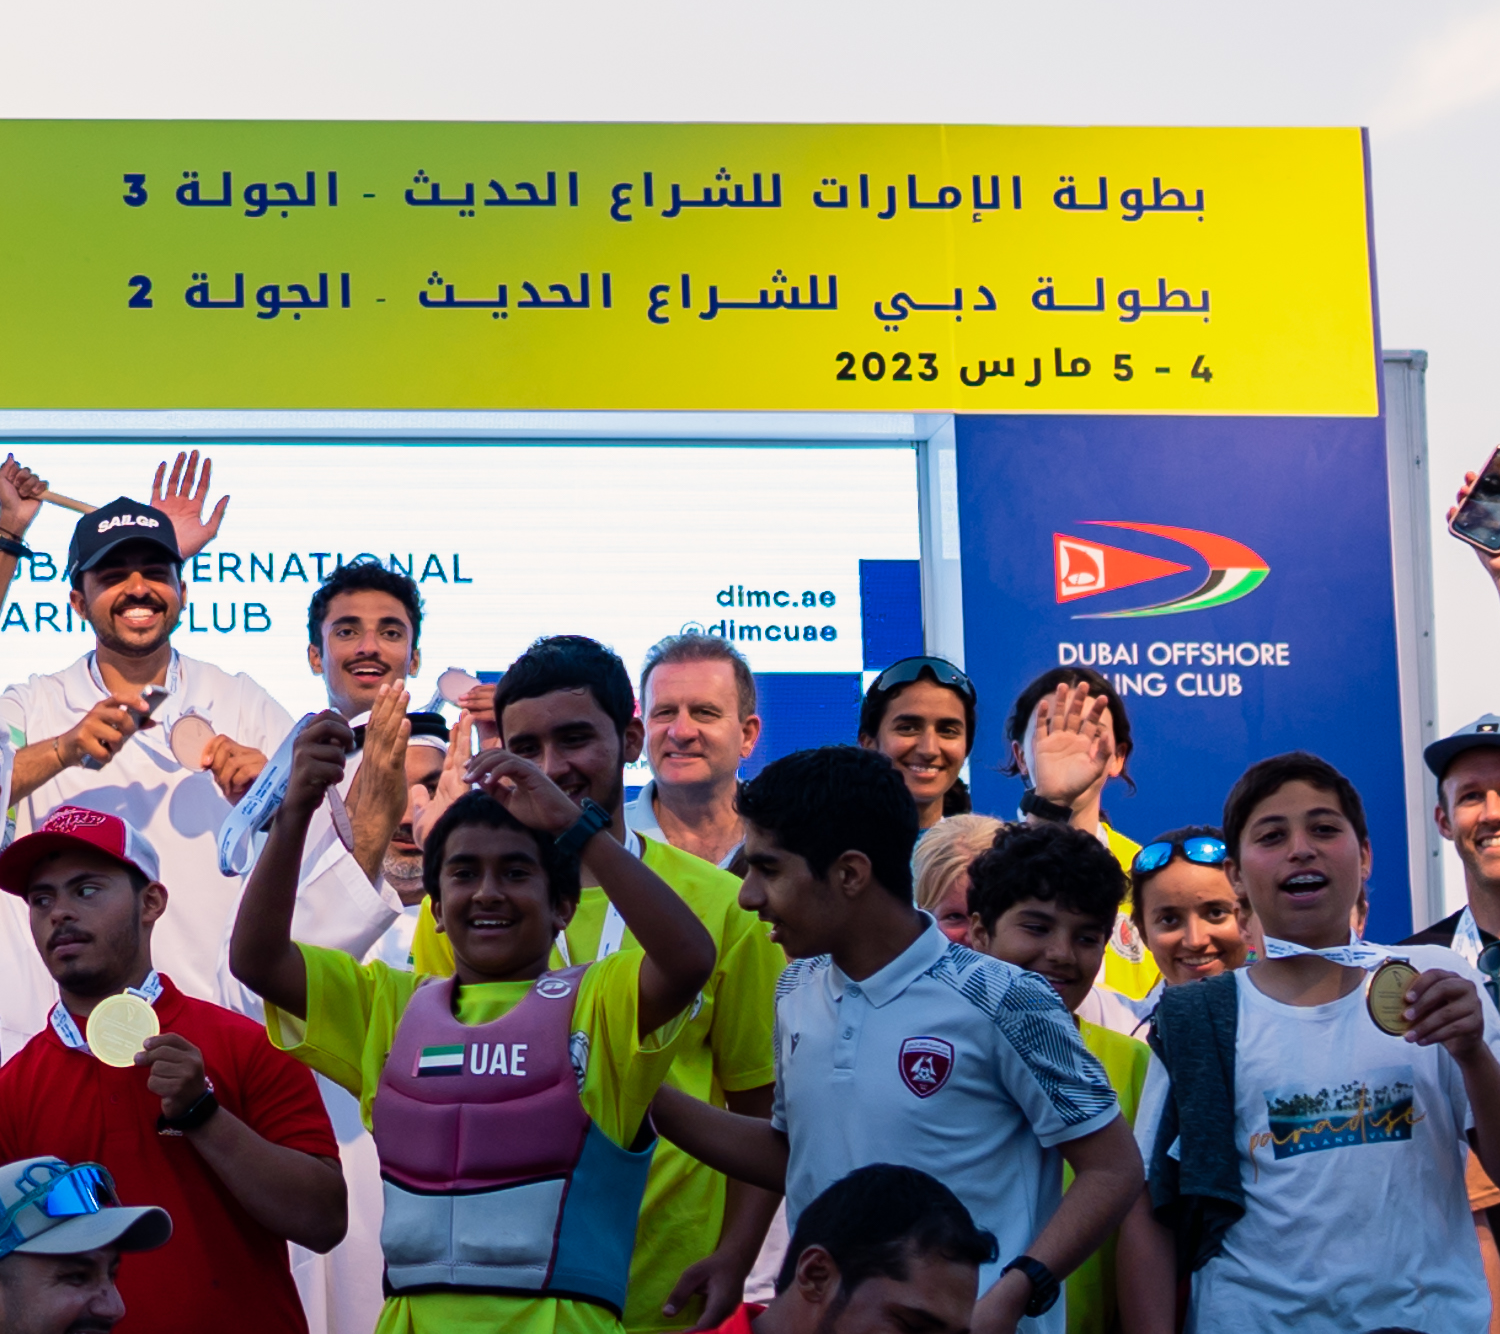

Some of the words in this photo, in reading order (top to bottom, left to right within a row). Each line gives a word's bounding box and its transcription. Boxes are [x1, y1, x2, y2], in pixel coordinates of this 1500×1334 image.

[122, 173, 149, 208] 3
[175, 170, 338, 219] الجولة
[404, 168, 579, 218] الحديث
[610, 166, 782, 222] للشراع
[813, 172, 1022, 223] الإمارات
[1053, 176, 1204, 222] بطولة
[127, 274, 153, 309] 2
[184, 272, 351, 321] الجولة
[418, 270, 612, 320] الحديث
[647, 269, 838, 325] للشراع
[874, 279, 997, 333] دبي
[1031, 277, 1209, 322] بطولة
[835, 351, 940, 382] 2023
[960, 347, 1092, 387] مارس
[1112, 354, 1134, 383] 5
[1190, 354, 1214, 383] 4
[716, 584, 837, 608] dimc.ae
[172, 601, 272, 634] LUB
[680, 619, 839, 642] @dimcuae
[1057, 641, 1139, 666] DUBAI
[1146, 641, 1291, 667] OFFSHORE
[1175, 672, 1243, 697] CLUB
[469, 1042, 529, 1077] UAE
[1249, 1082, 1427, 1185] paradise
[1288, 1134, 1356, 1154] ISLAND
